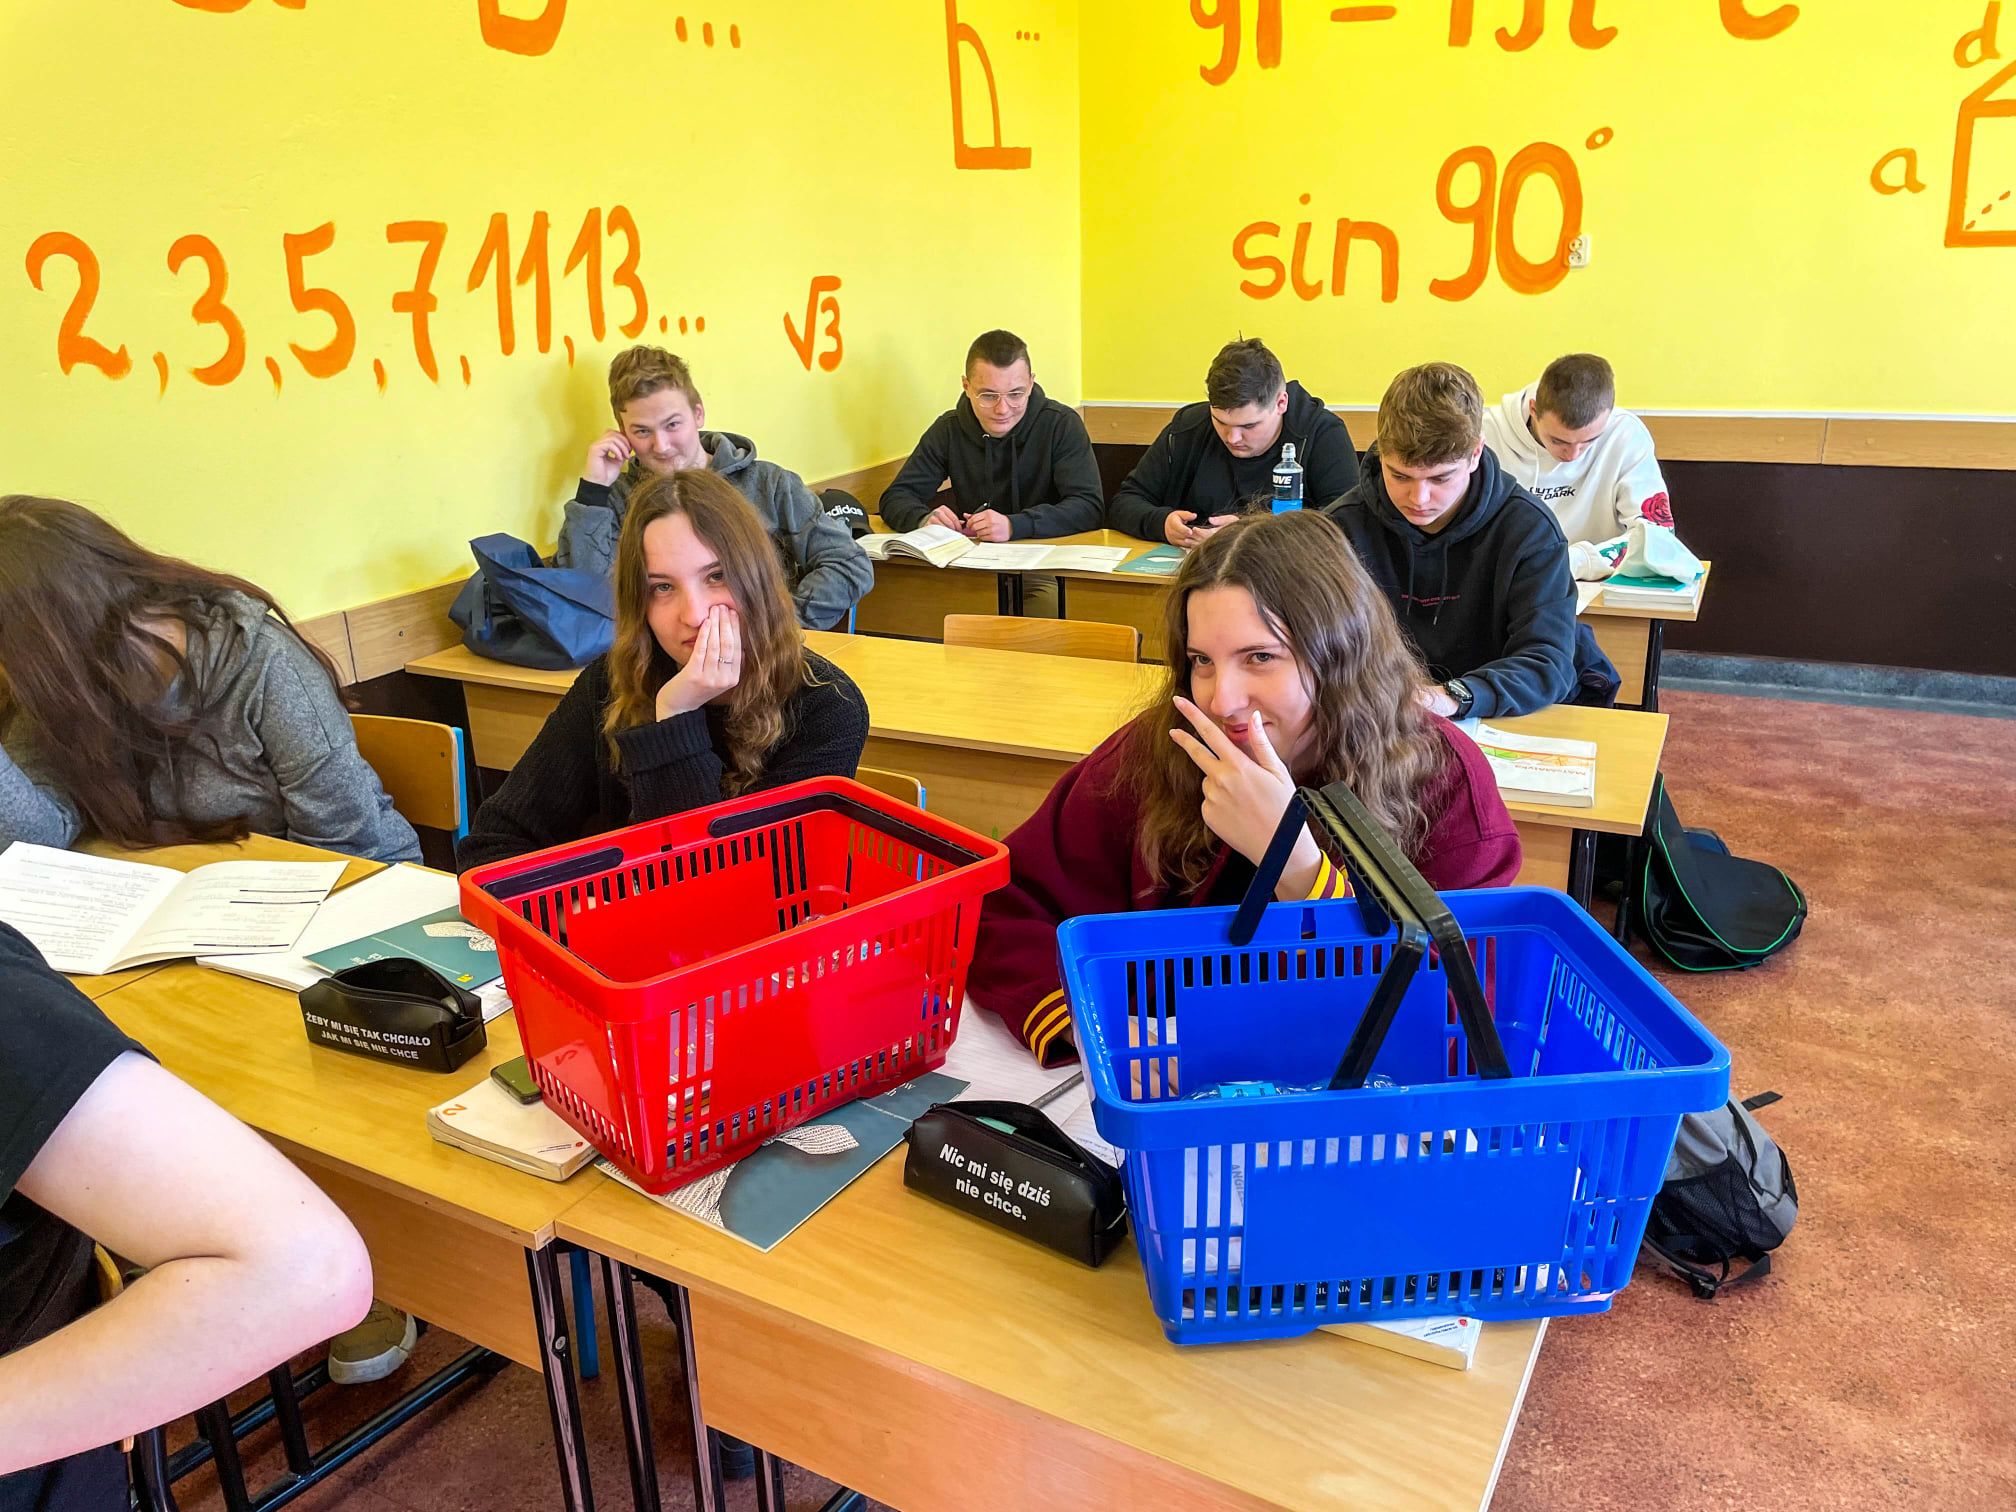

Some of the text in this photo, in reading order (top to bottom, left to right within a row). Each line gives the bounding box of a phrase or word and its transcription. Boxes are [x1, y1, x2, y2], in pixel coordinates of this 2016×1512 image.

[1870, 147, 1926, 195] a
[1232, 192, 1400, 303] sin
[825, 504, 864, 517] adidas
[1543, 488, 1577, 500] DARK
[305, 1011, 431, 1046] ŻEBY MI SIĘ TAK CHCIAŁO
[321, 1030, 419, 1060] JAK MI SIĘ NIE CHCE
[939, 1143, 1051, 1207] Nic mi się dziś
[955, 1178, 1027, 1221] nie chce.
